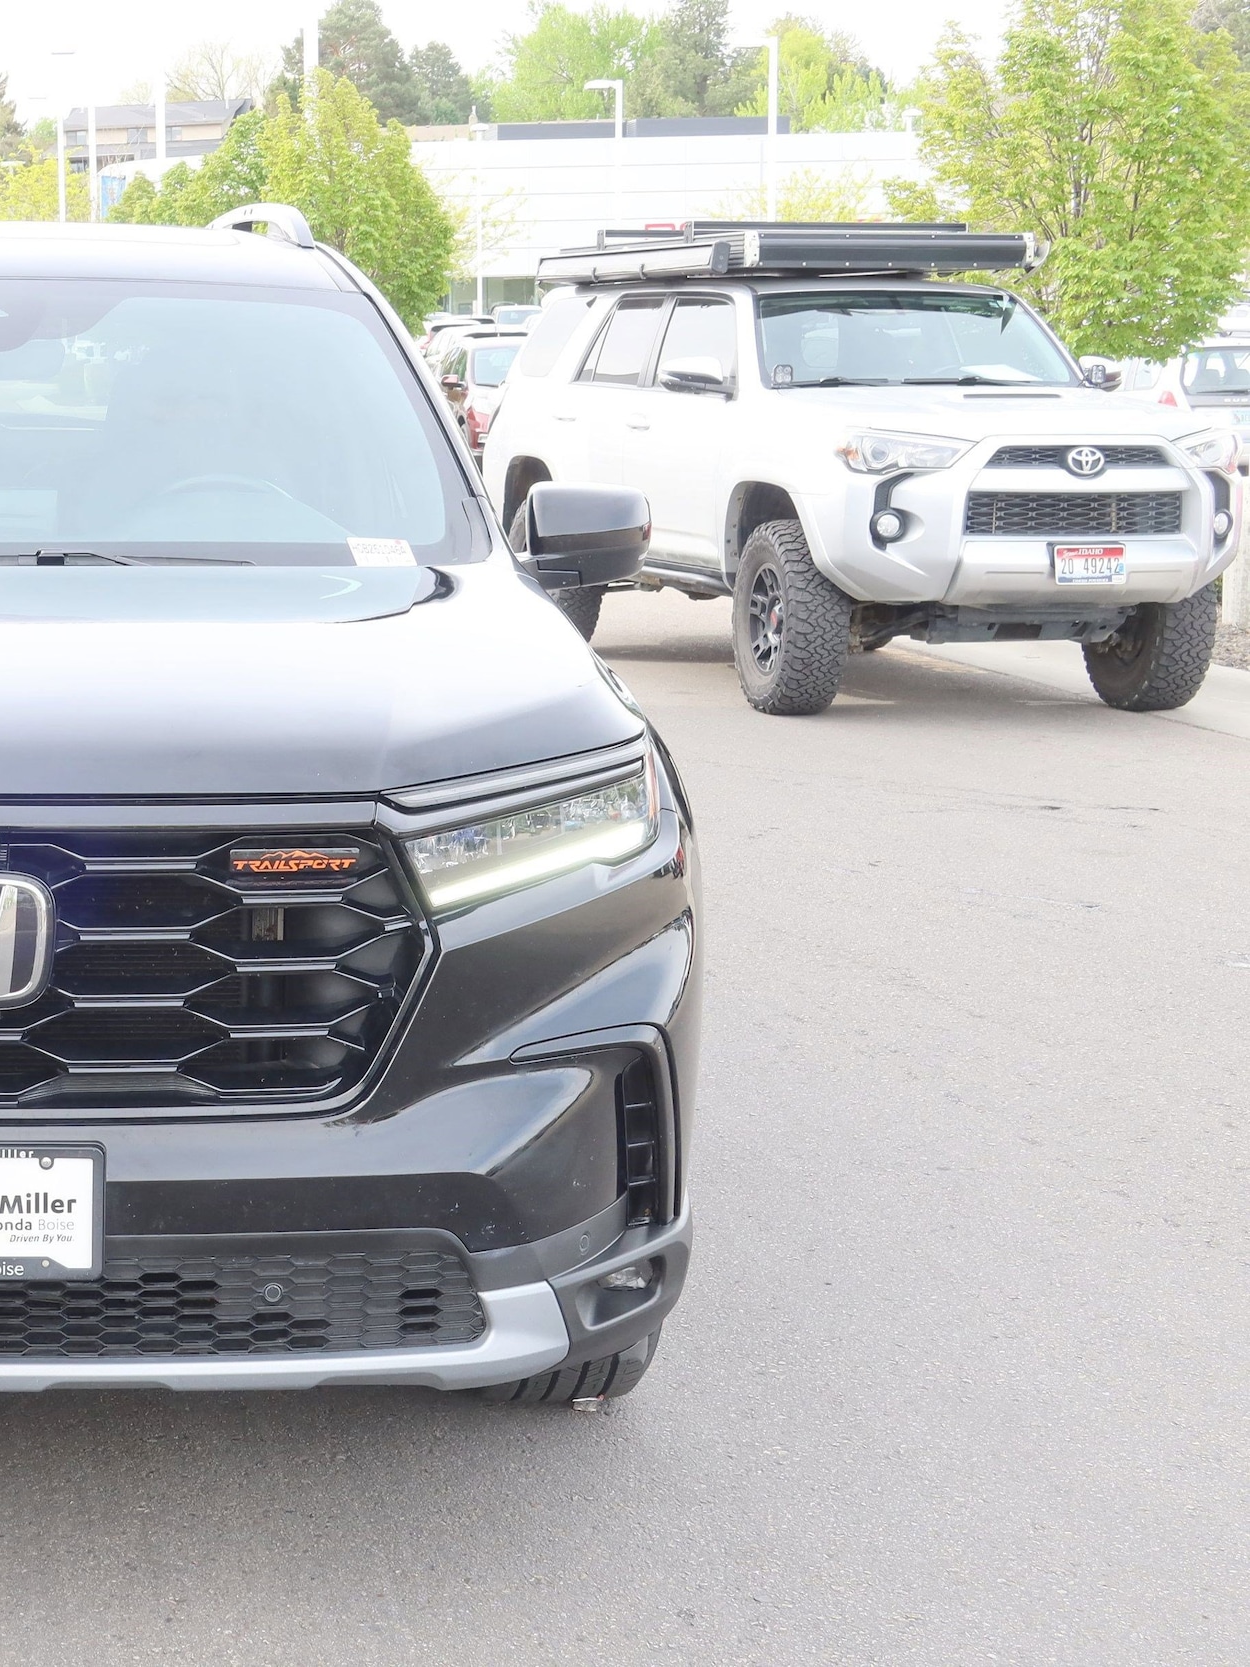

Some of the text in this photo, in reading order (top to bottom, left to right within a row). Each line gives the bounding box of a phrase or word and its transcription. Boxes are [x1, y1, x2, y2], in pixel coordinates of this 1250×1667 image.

[1061, 557, 1120, 574] 20 49242
[233, 858, 357, 872] TRAILSPORT
[0, 1192, 77, 1214] Miller
[38, 1219, 75, 1231] Boise
[9, 1234, 40, 1243] Driven
[42, 1234, 54, 1244] By
